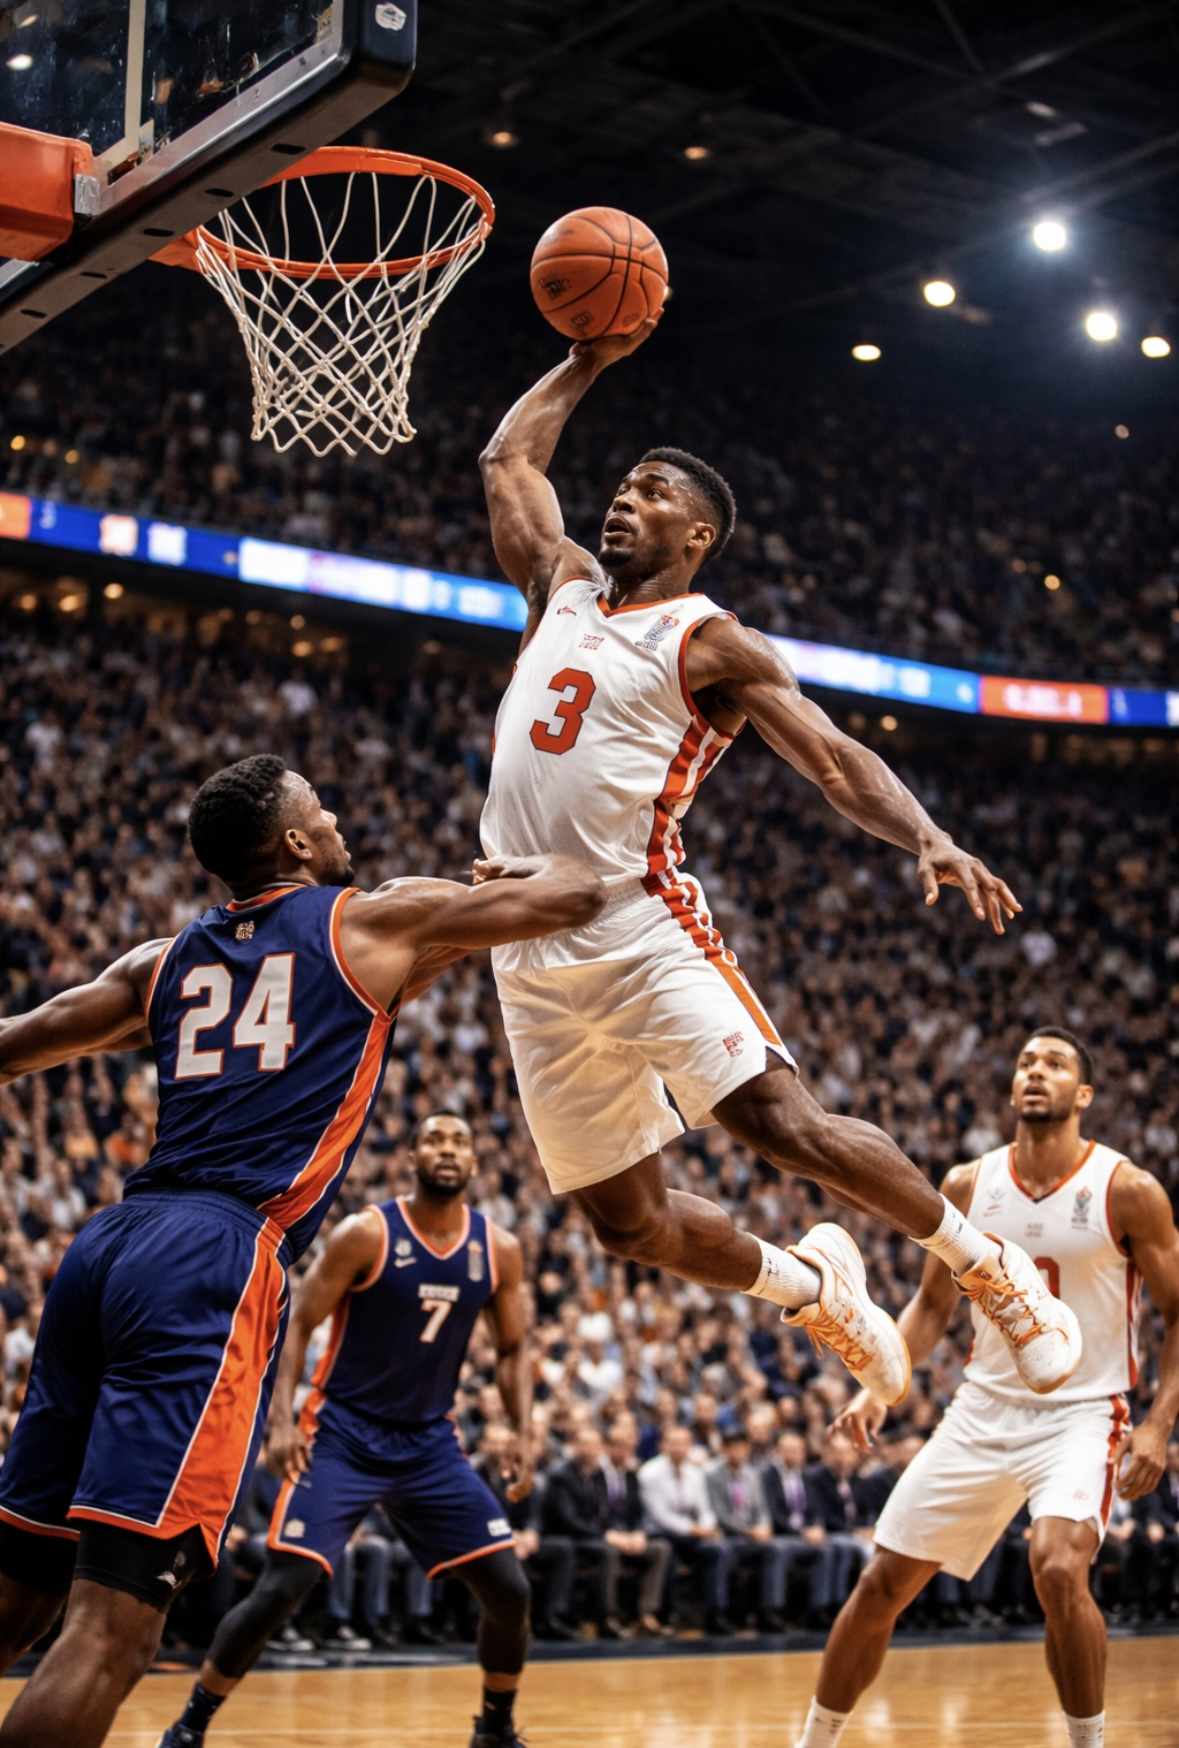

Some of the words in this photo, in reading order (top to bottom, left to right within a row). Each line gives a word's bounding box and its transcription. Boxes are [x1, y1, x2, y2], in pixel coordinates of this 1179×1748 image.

[529, 667, 596, 755] 3
[174, 952, 297, 1080] 24
[419, 1299, 452, 1343] 7
